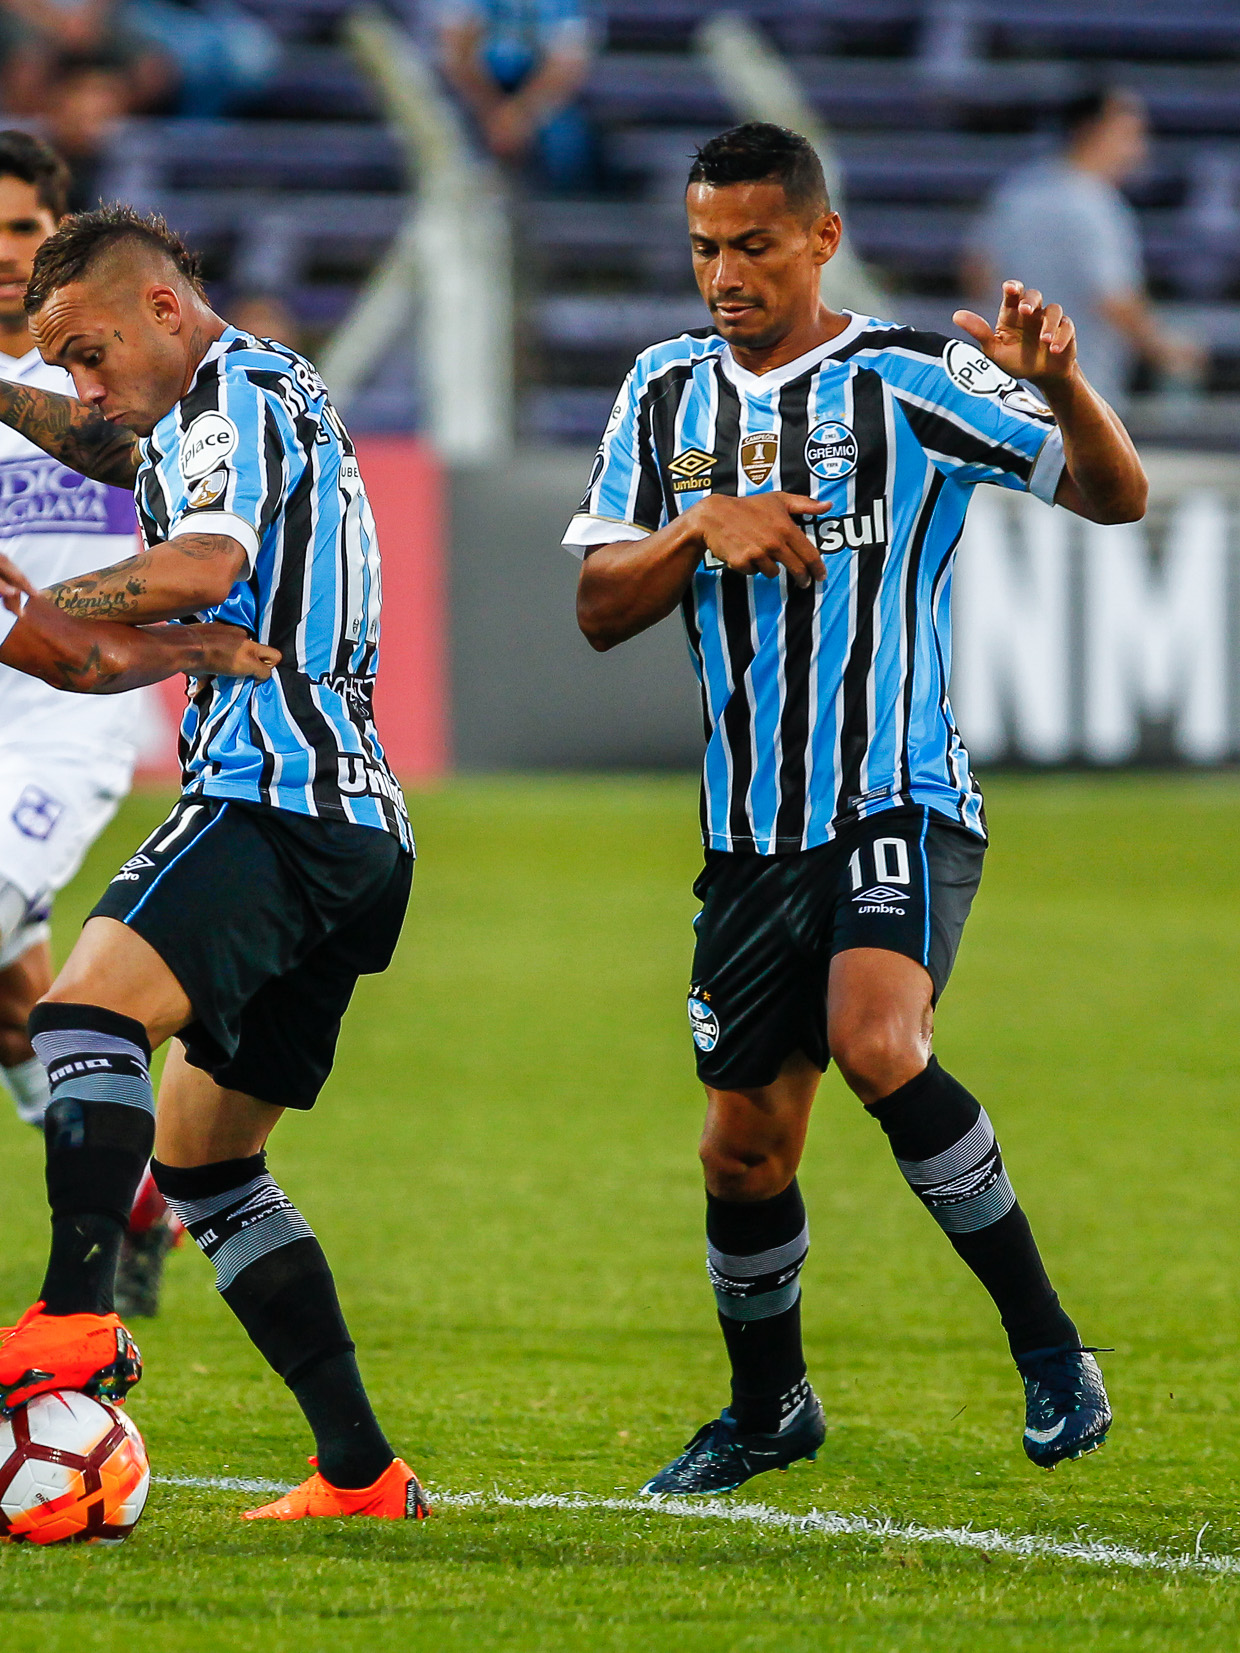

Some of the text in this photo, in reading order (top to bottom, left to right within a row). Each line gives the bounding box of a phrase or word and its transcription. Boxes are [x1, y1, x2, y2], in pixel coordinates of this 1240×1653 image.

[953, 357, 991, 390] iPla
[808, 443, 855, 460] GRÊMIO
[673, 477, 712, 491] umbro
[848, 837, 910, 892] 10
[858, 903, 906, 916] umbro
